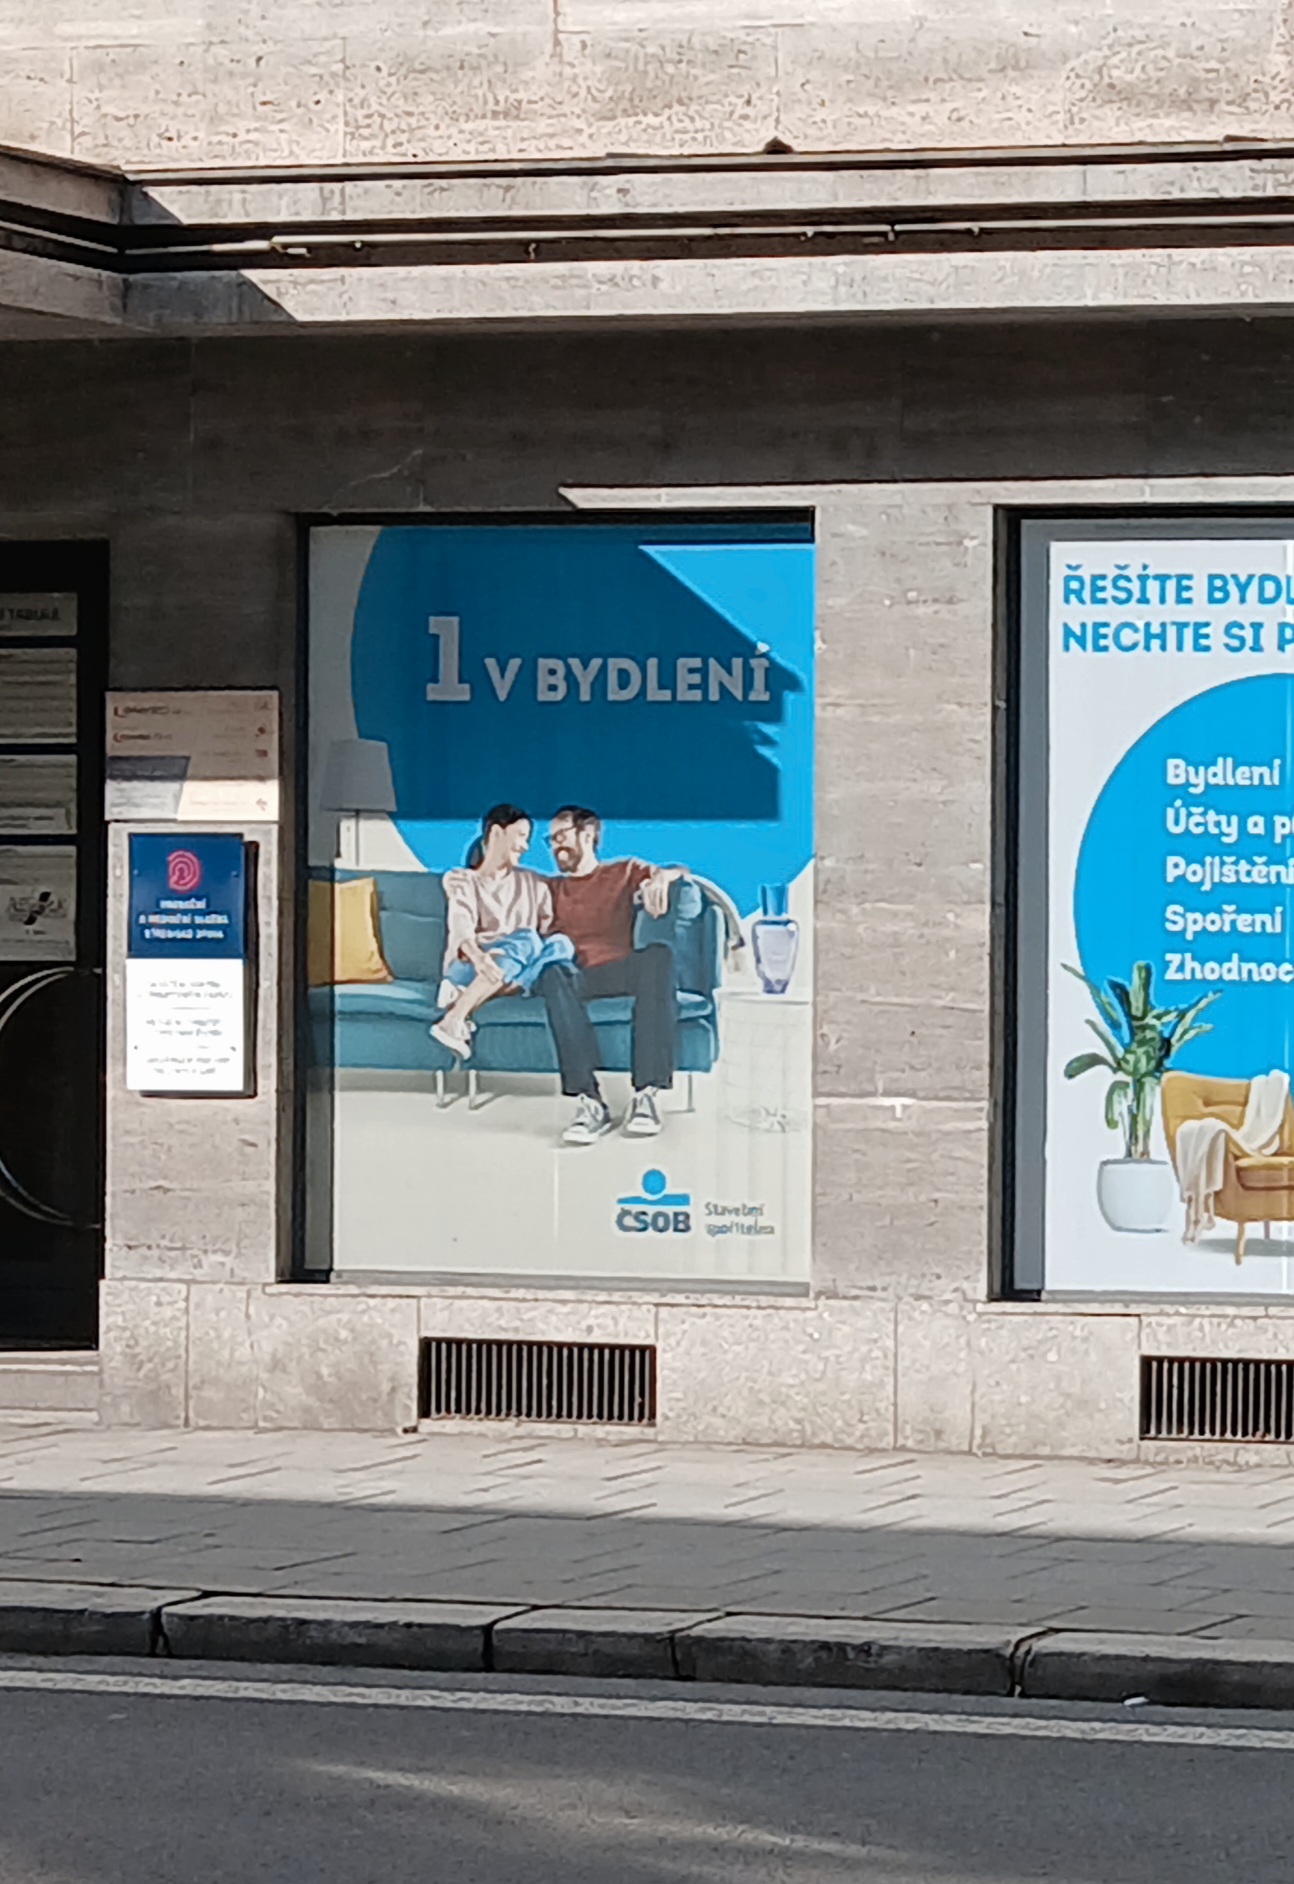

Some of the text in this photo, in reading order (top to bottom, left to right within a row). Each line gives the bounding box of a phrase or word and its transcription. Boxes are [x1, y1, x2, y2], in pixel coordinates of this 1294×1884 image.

[1062, 563, 1194, 606] ŘEŠÍTE
[1062, 620, 1212, 653] NECHTE
[1223, 620, 1265, 653] SI
[425, 615, 771, 702] 1 V BYDLENÍ
[1165, 757, 1281, 795] Bydlení
[1165, 799, 1239, 843] Účty
[1246, 814, 1266, 837] a
[1164, 903, 1283, 941] Spoření
[616, 1207, 692, 1233] ČSOB
